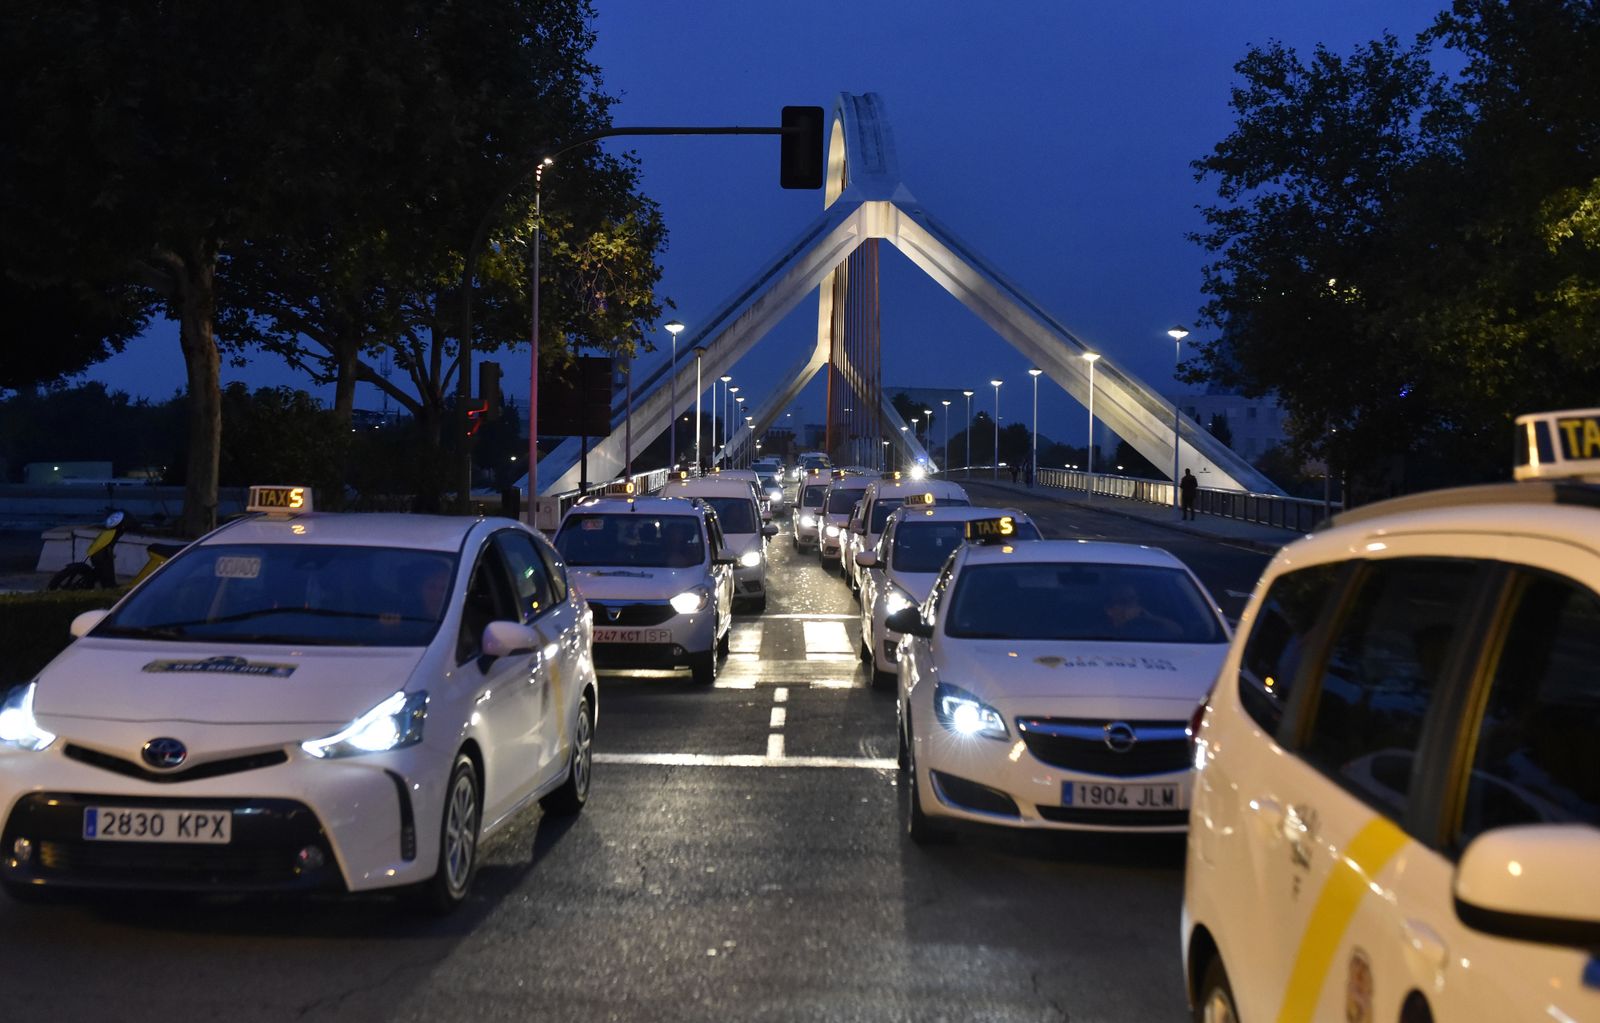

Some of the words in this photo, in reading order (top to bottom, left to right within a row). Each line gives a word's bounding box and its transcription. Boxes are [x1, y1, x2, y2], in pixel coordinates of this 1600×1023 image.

[620, 630, 641, 641] KCT
[1080, 785, 1129, 806] 1904
[1136, 787, 1175, 807] JLM
[101, 811, 165, 837] 2830
[177, 812, 226, 839] KPX
